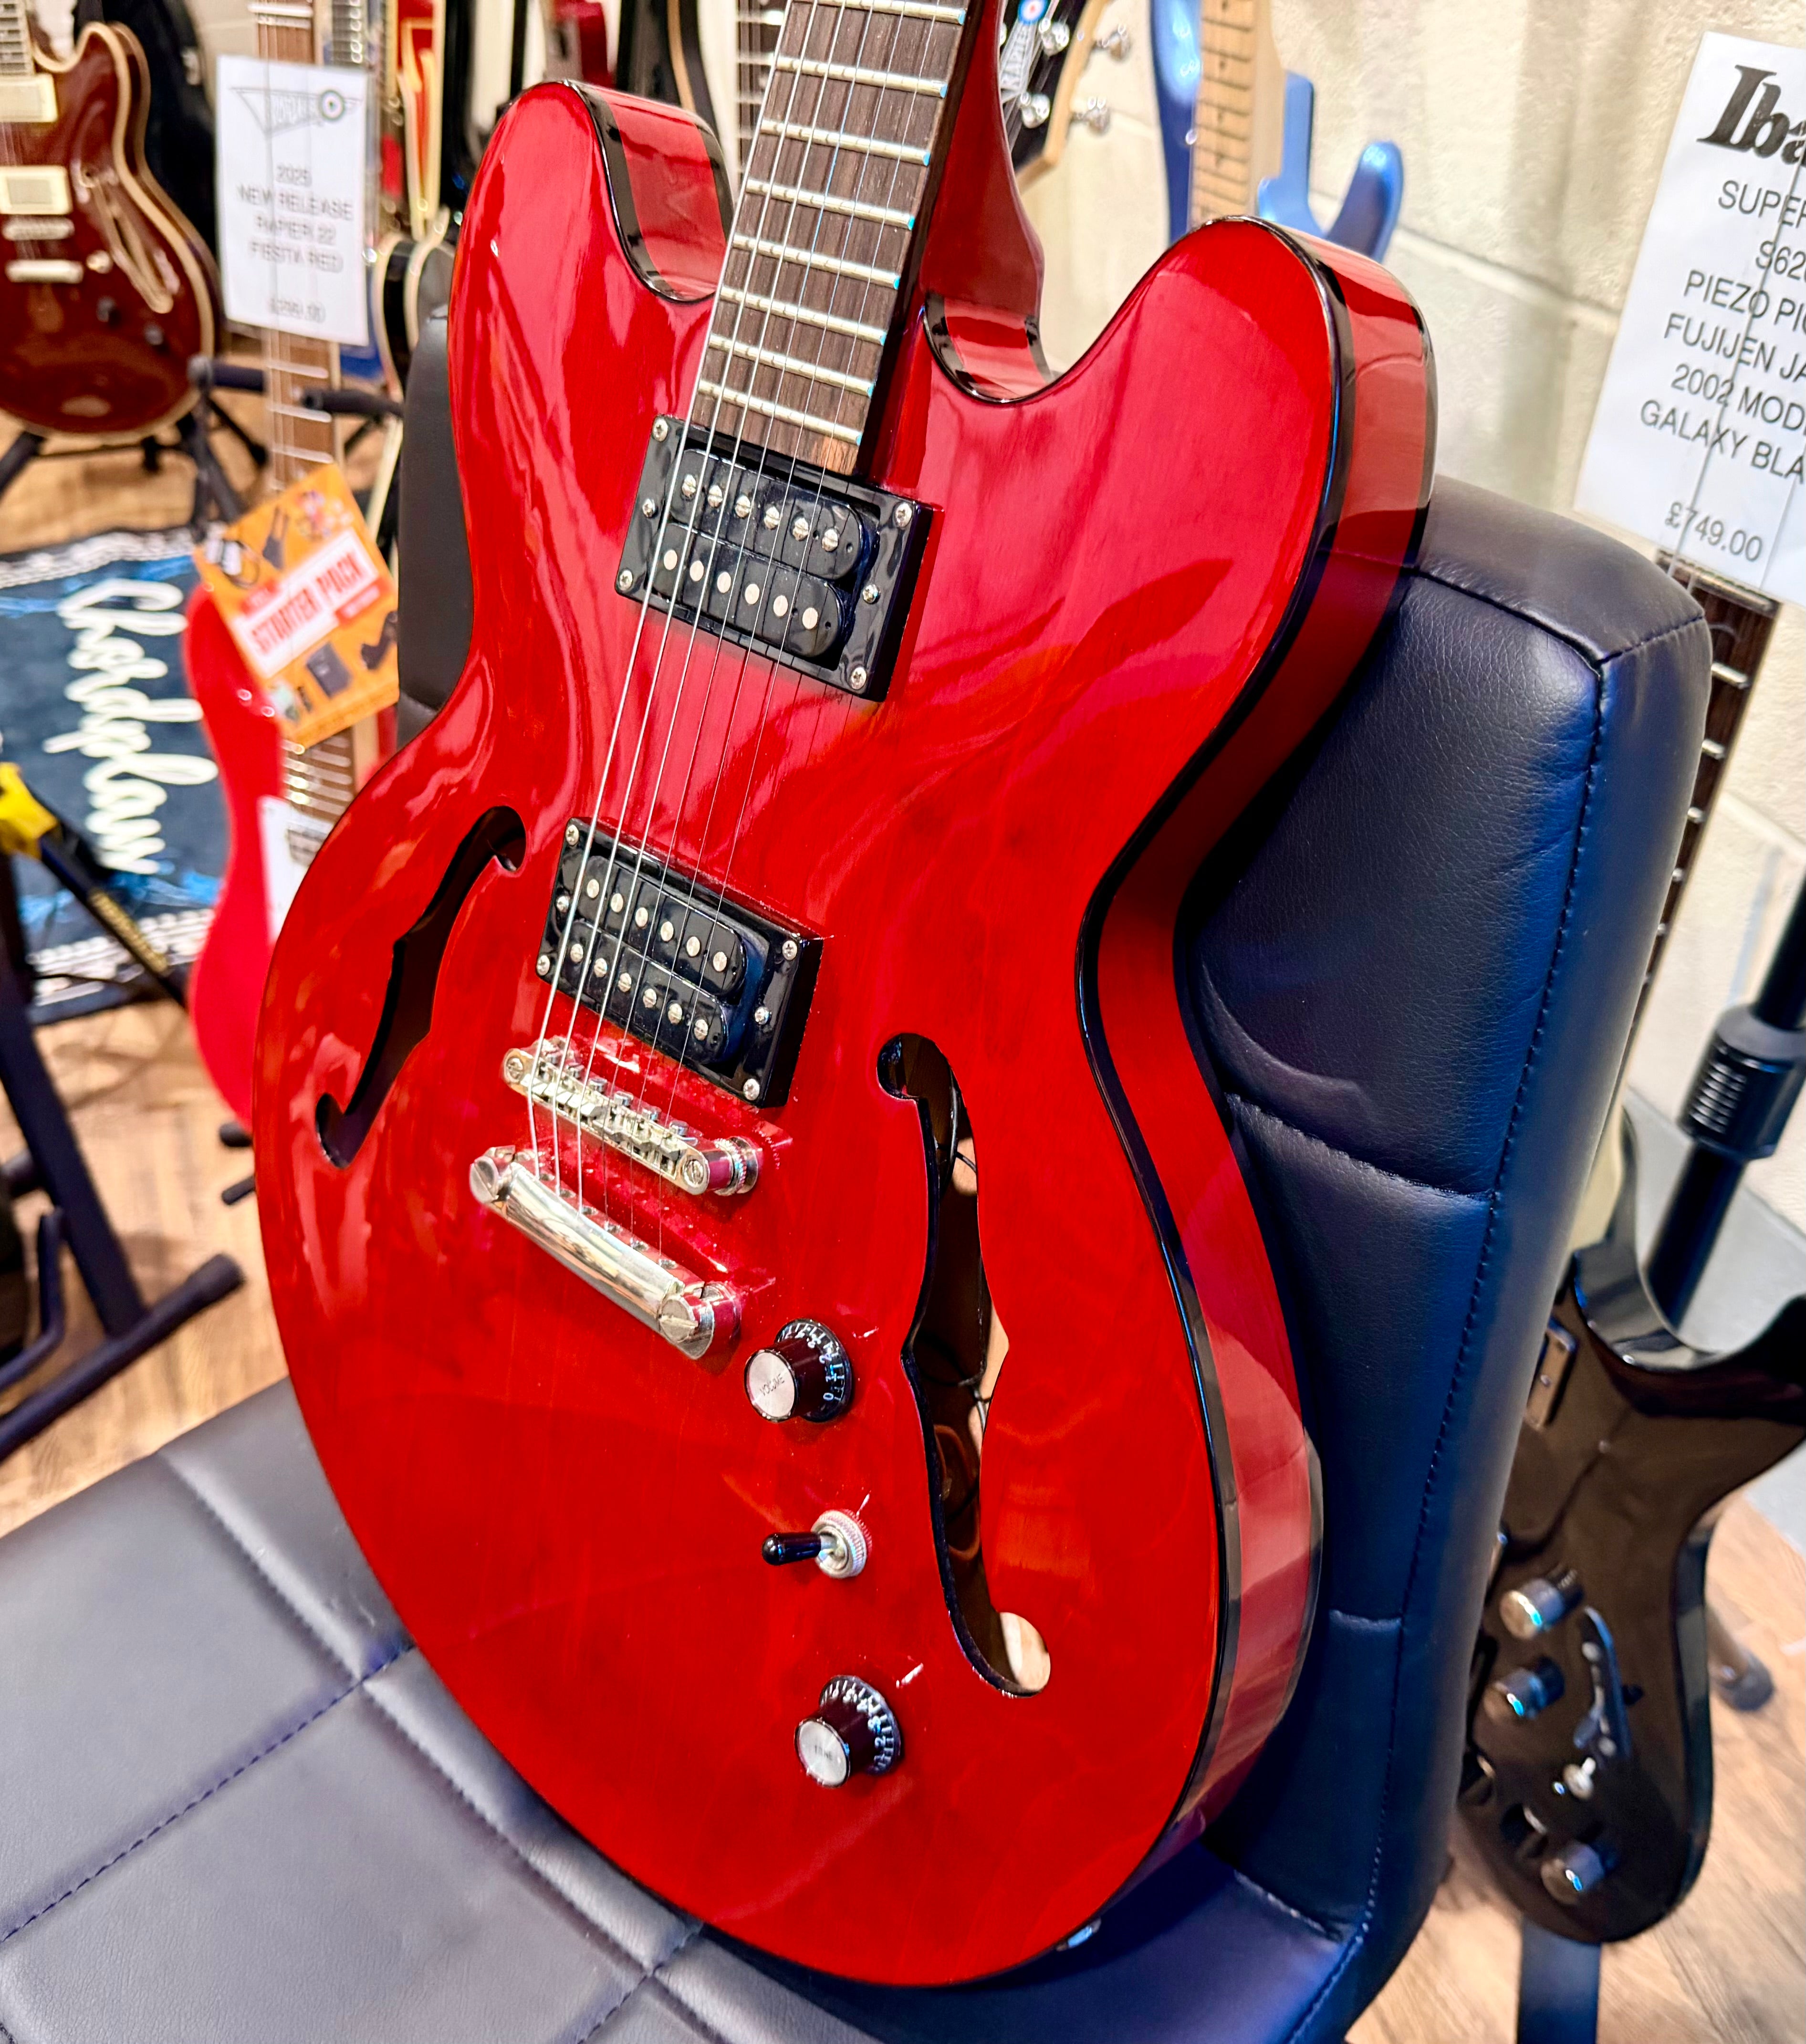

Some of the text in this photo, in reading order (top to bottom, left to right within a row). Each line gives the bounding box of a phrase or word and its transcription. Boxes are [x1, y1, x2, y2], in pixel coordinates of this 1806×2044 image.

[278, 192, 354, 221] RELEASE
[1756, 240, 1806, 283] S62
[1684, 270, 1806, 336] PIEZO PI
[1664, 313, 1776, 373] FUJIJEN
[1640, 400, 1748, 459] GALAXY
[1671, 364, 1806, 436] 2002 MOD
[1664, 501, 1763, 563] £749.00
